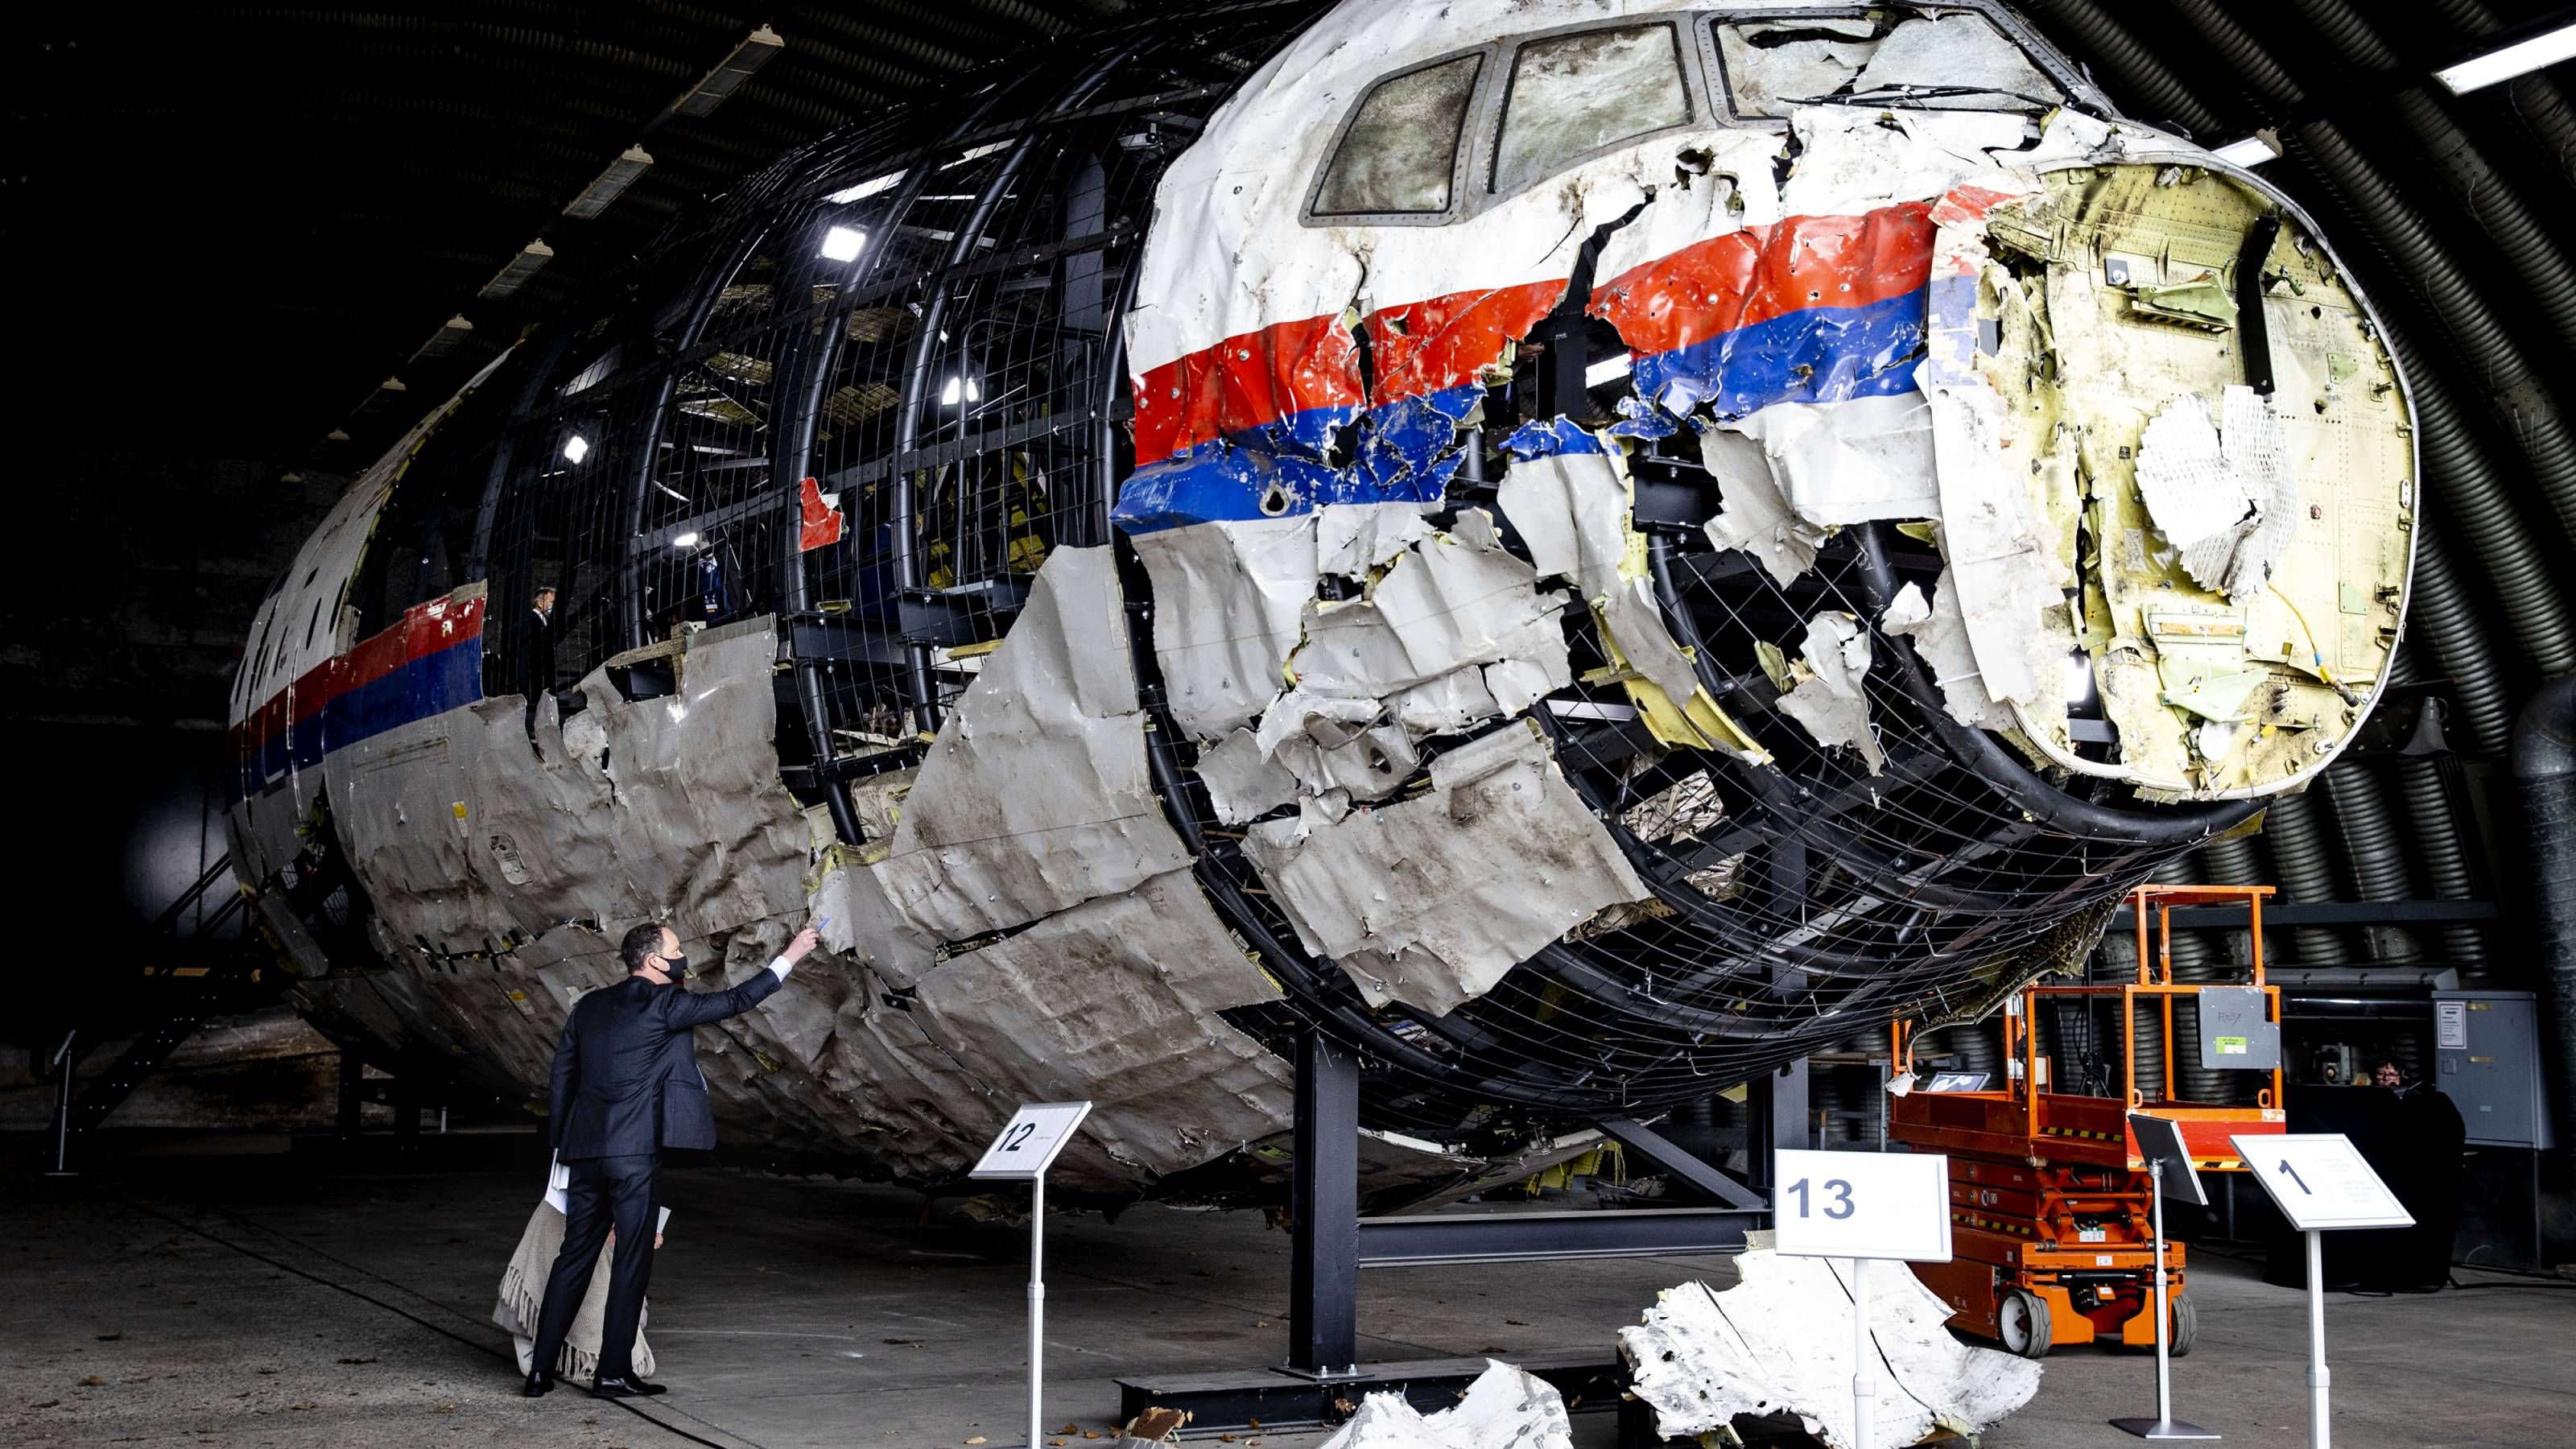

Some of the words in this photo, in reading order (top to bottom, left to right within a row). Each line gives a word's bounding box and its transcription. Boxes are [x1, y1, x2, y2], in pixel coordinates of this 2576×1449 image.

[997, 1123, 1035, 1151] 12
[2279, 1159, 2312, 1195] 1
[1788, 1178, 1855, 1220] 13
